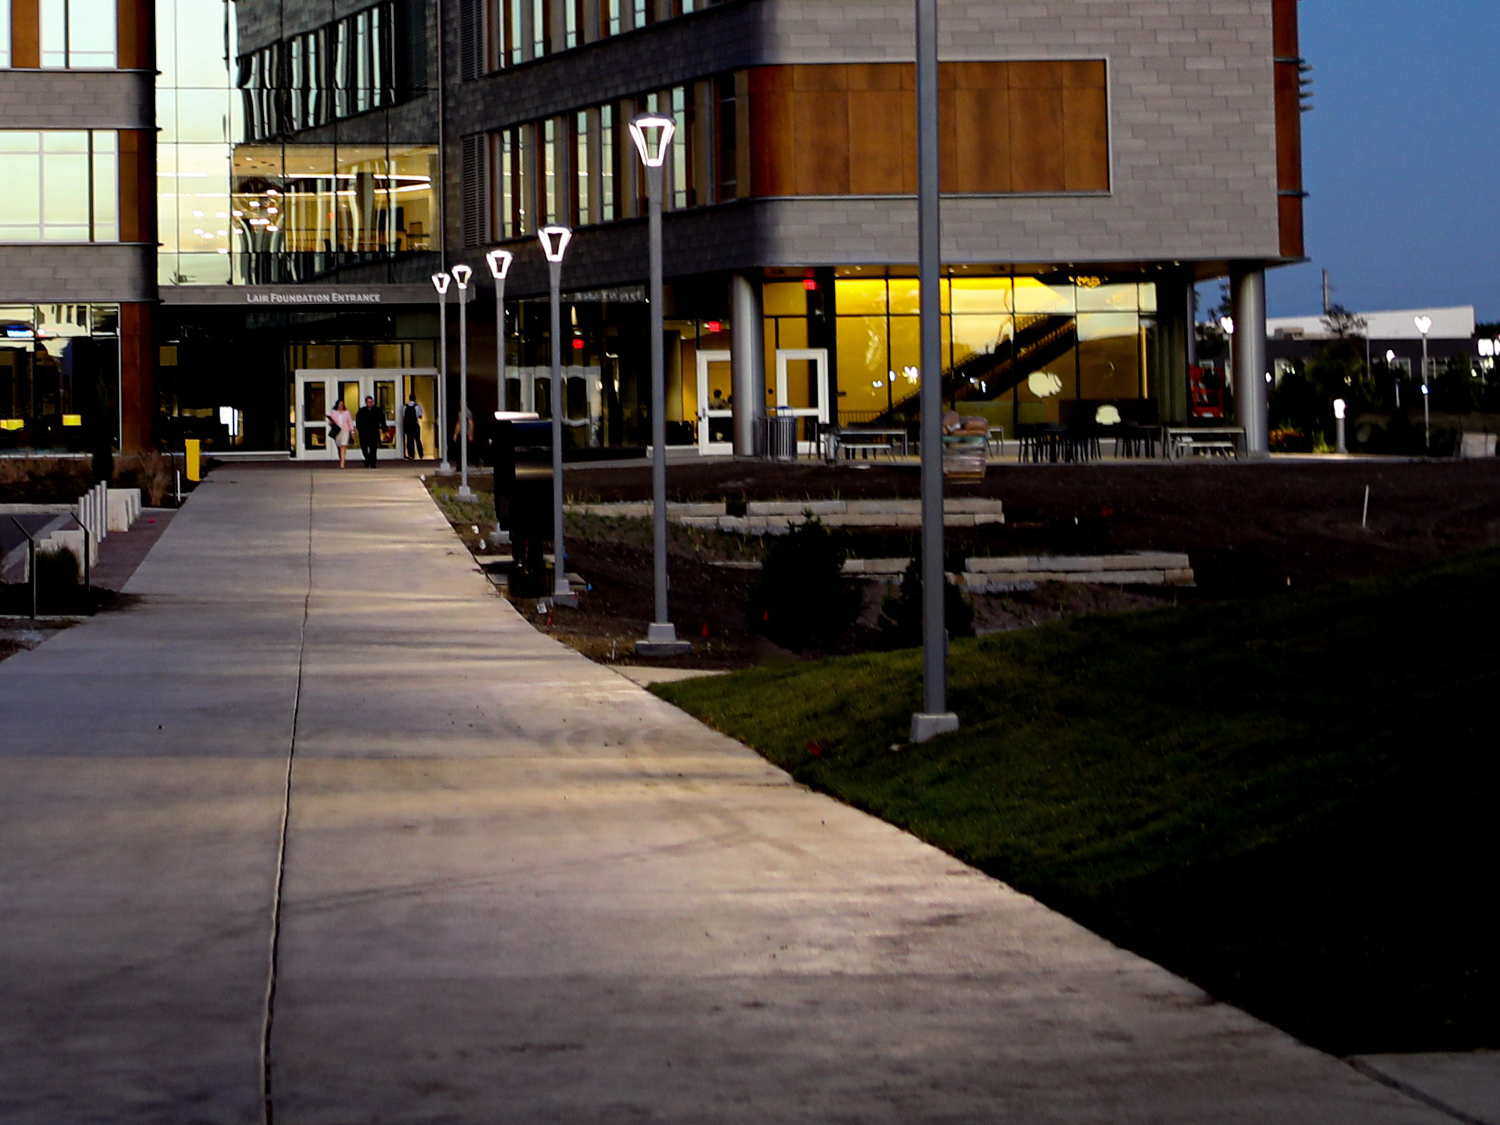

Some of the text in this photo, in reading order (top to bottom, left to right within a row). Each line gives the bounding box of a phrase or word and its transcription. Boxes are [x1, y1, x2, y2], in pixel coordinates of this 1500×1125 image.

[246, 291, 381, 303] LAIR FOUNDATION ENTRANCE
